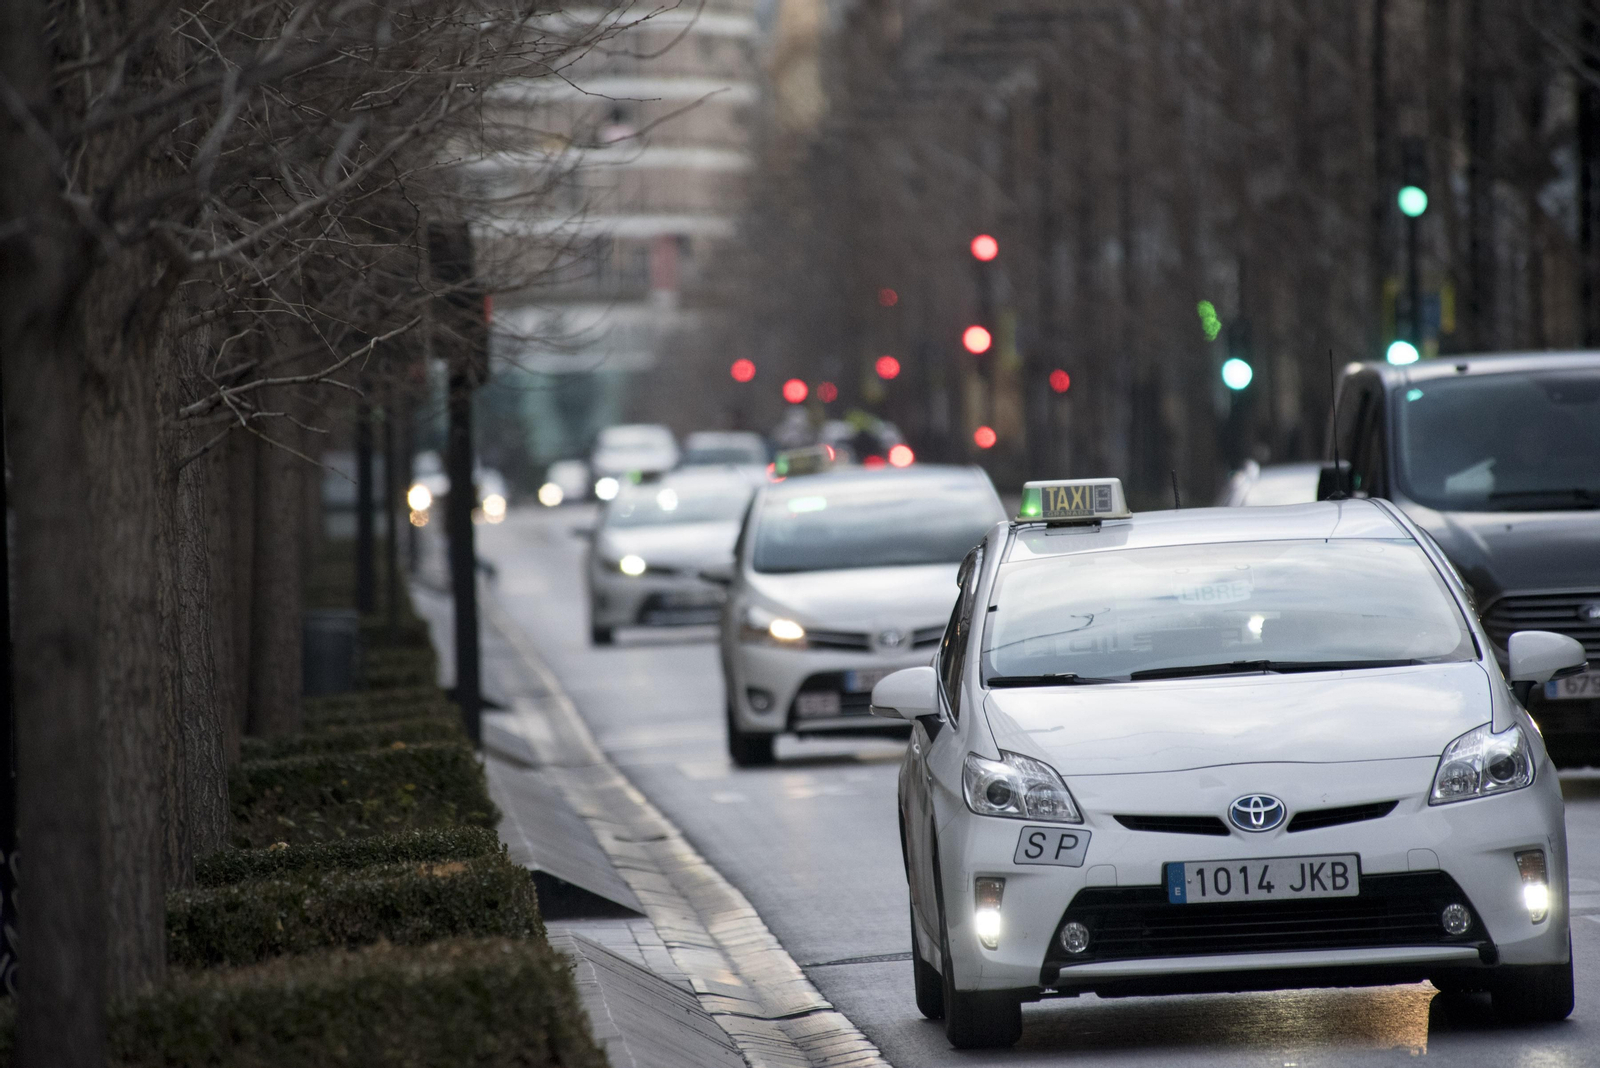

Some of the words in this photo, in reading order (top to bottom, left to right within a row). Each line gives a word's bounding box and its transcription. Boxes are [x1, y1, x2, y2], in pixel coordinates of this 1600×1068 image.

[1045, 485, 1091, 510] TAXI
[1047, 509, 1090, 517] GRANADA
[1181, 581, 1245, 601] LIBRE
[1196, 864, 1275, 897] 1014
[1289, 861, 1350, 893] JKB
[1174, 887, 1181, 896] E
